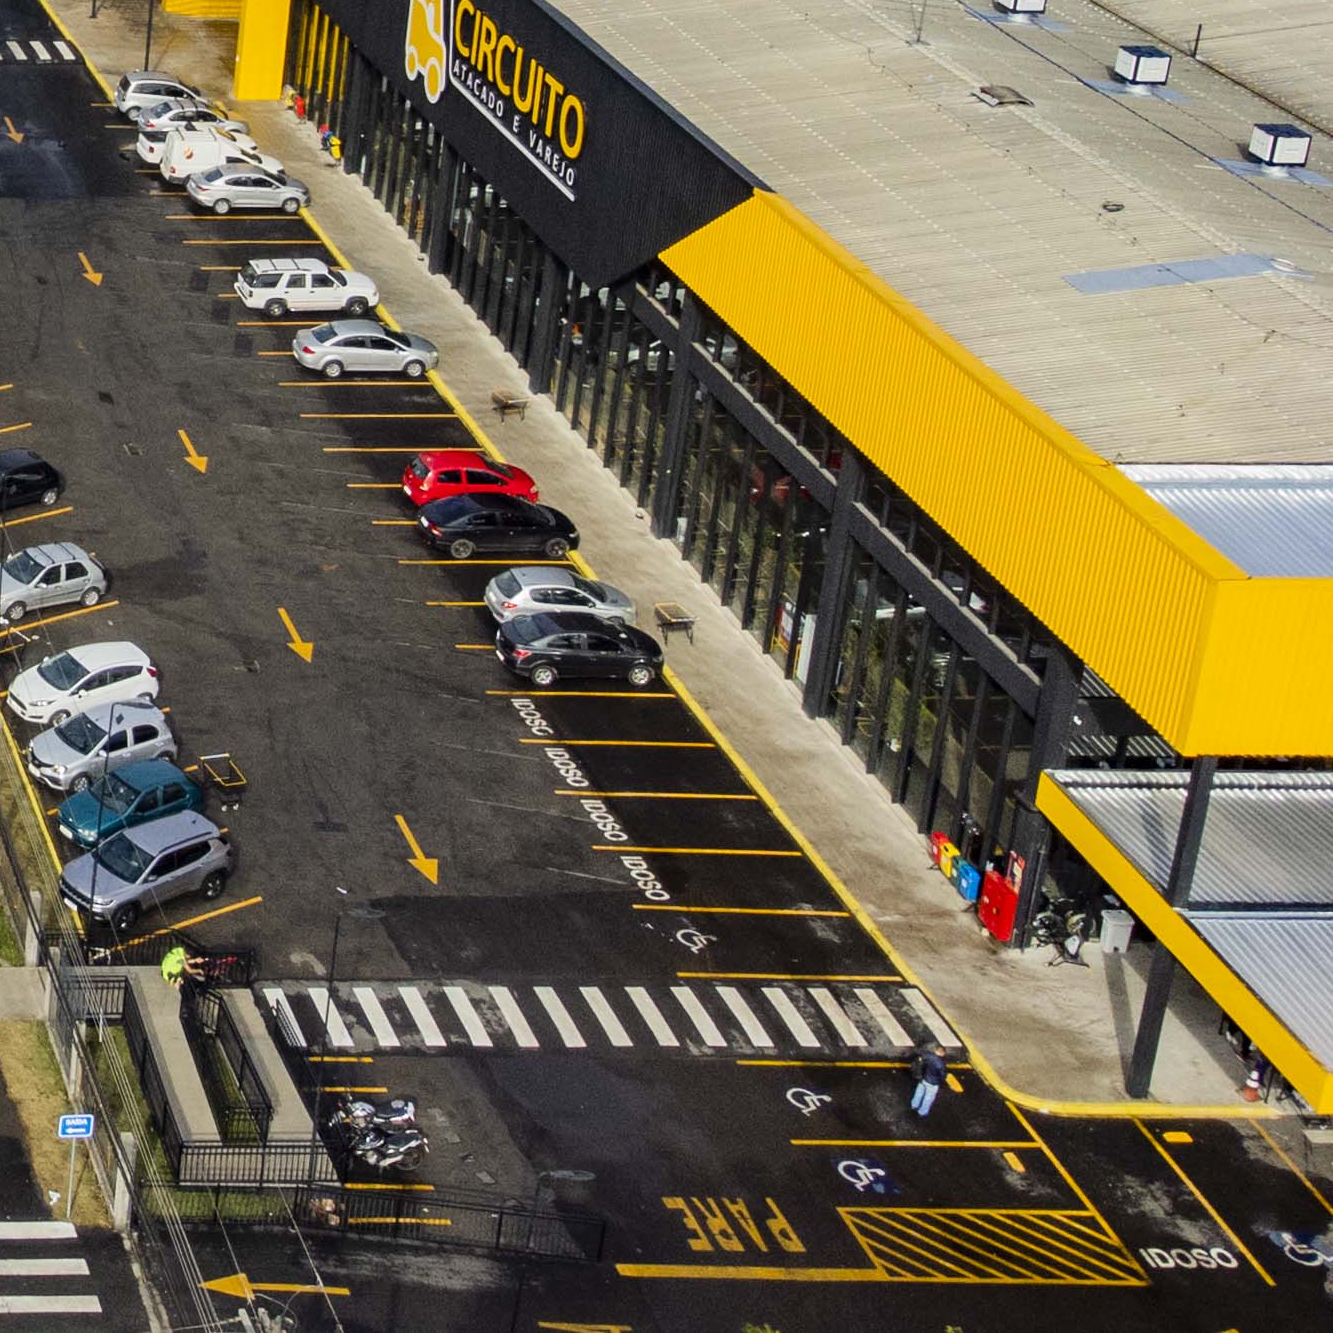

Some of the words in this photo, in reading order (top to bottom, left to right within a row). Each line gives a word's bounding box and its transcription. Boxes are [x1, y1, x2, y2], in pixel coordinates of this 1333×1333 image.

[453, 59, 504, 117] ATACADO
[512, 115, 521, 132] E
[529, 129, 575, 186] VAREJO
[544, 747, 589, 788] IDOSO
[580, 799, 628, 842] IDOSO
[620, 856, 670, 901] IDOSO
[661, 1196, 806, 1252] PARE
[1139, 1247, 1239, 1269] IDOSO
